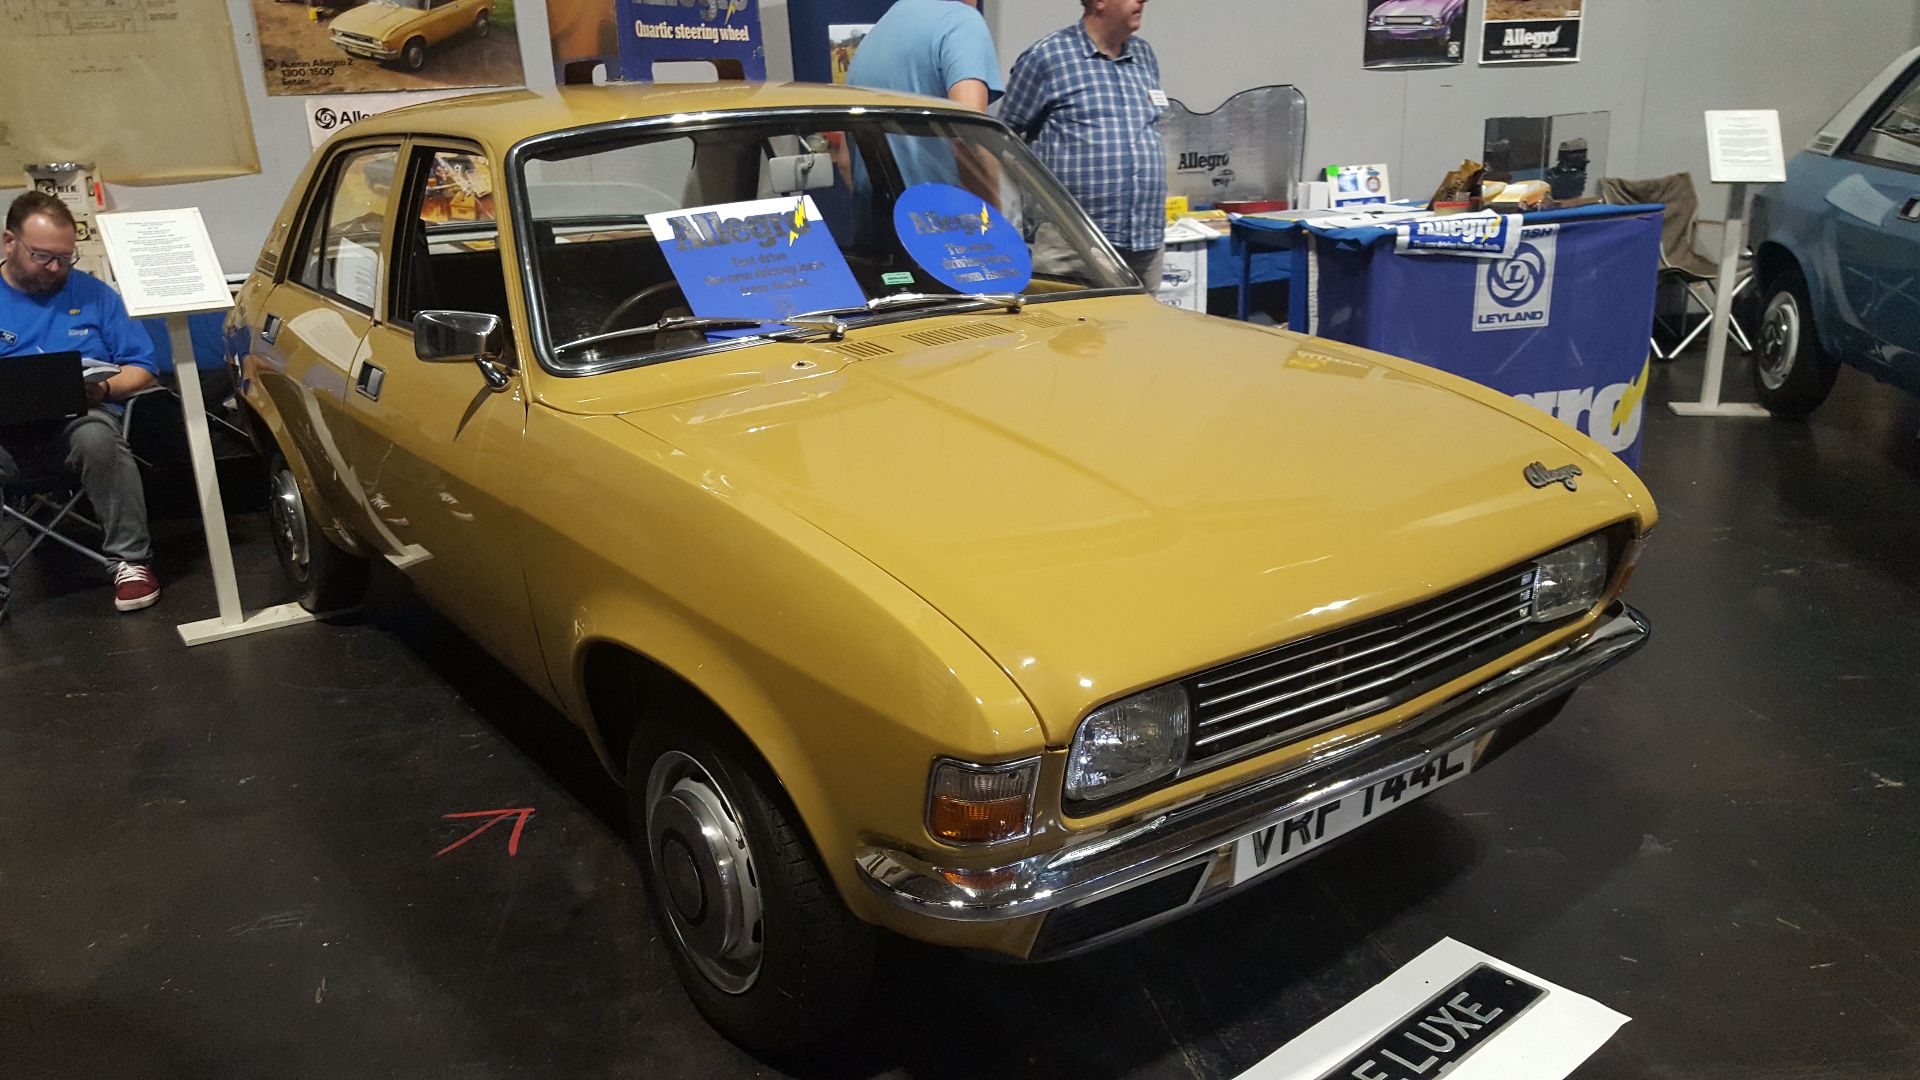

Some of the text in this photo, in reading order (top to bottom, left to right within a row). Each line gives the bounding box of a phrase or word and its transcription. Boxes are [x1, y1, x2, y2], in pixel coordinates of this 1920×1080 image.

[635, 20, 750, 43] Quartic steering wheel
[1502, 26, 1561, 48] Allegro
[281, 66, 335, 77] 1300 1500
[346, 57, 354, 66] 2
[1177, 152, 1230, 172] Allegro
[665, 206, 812, 251] Allegro
[908, 210, 993, 235] Allegro
[1478, 310, 1544, 324] LEYLAND
[1252, 753, 1465, 868] VRF 144L
